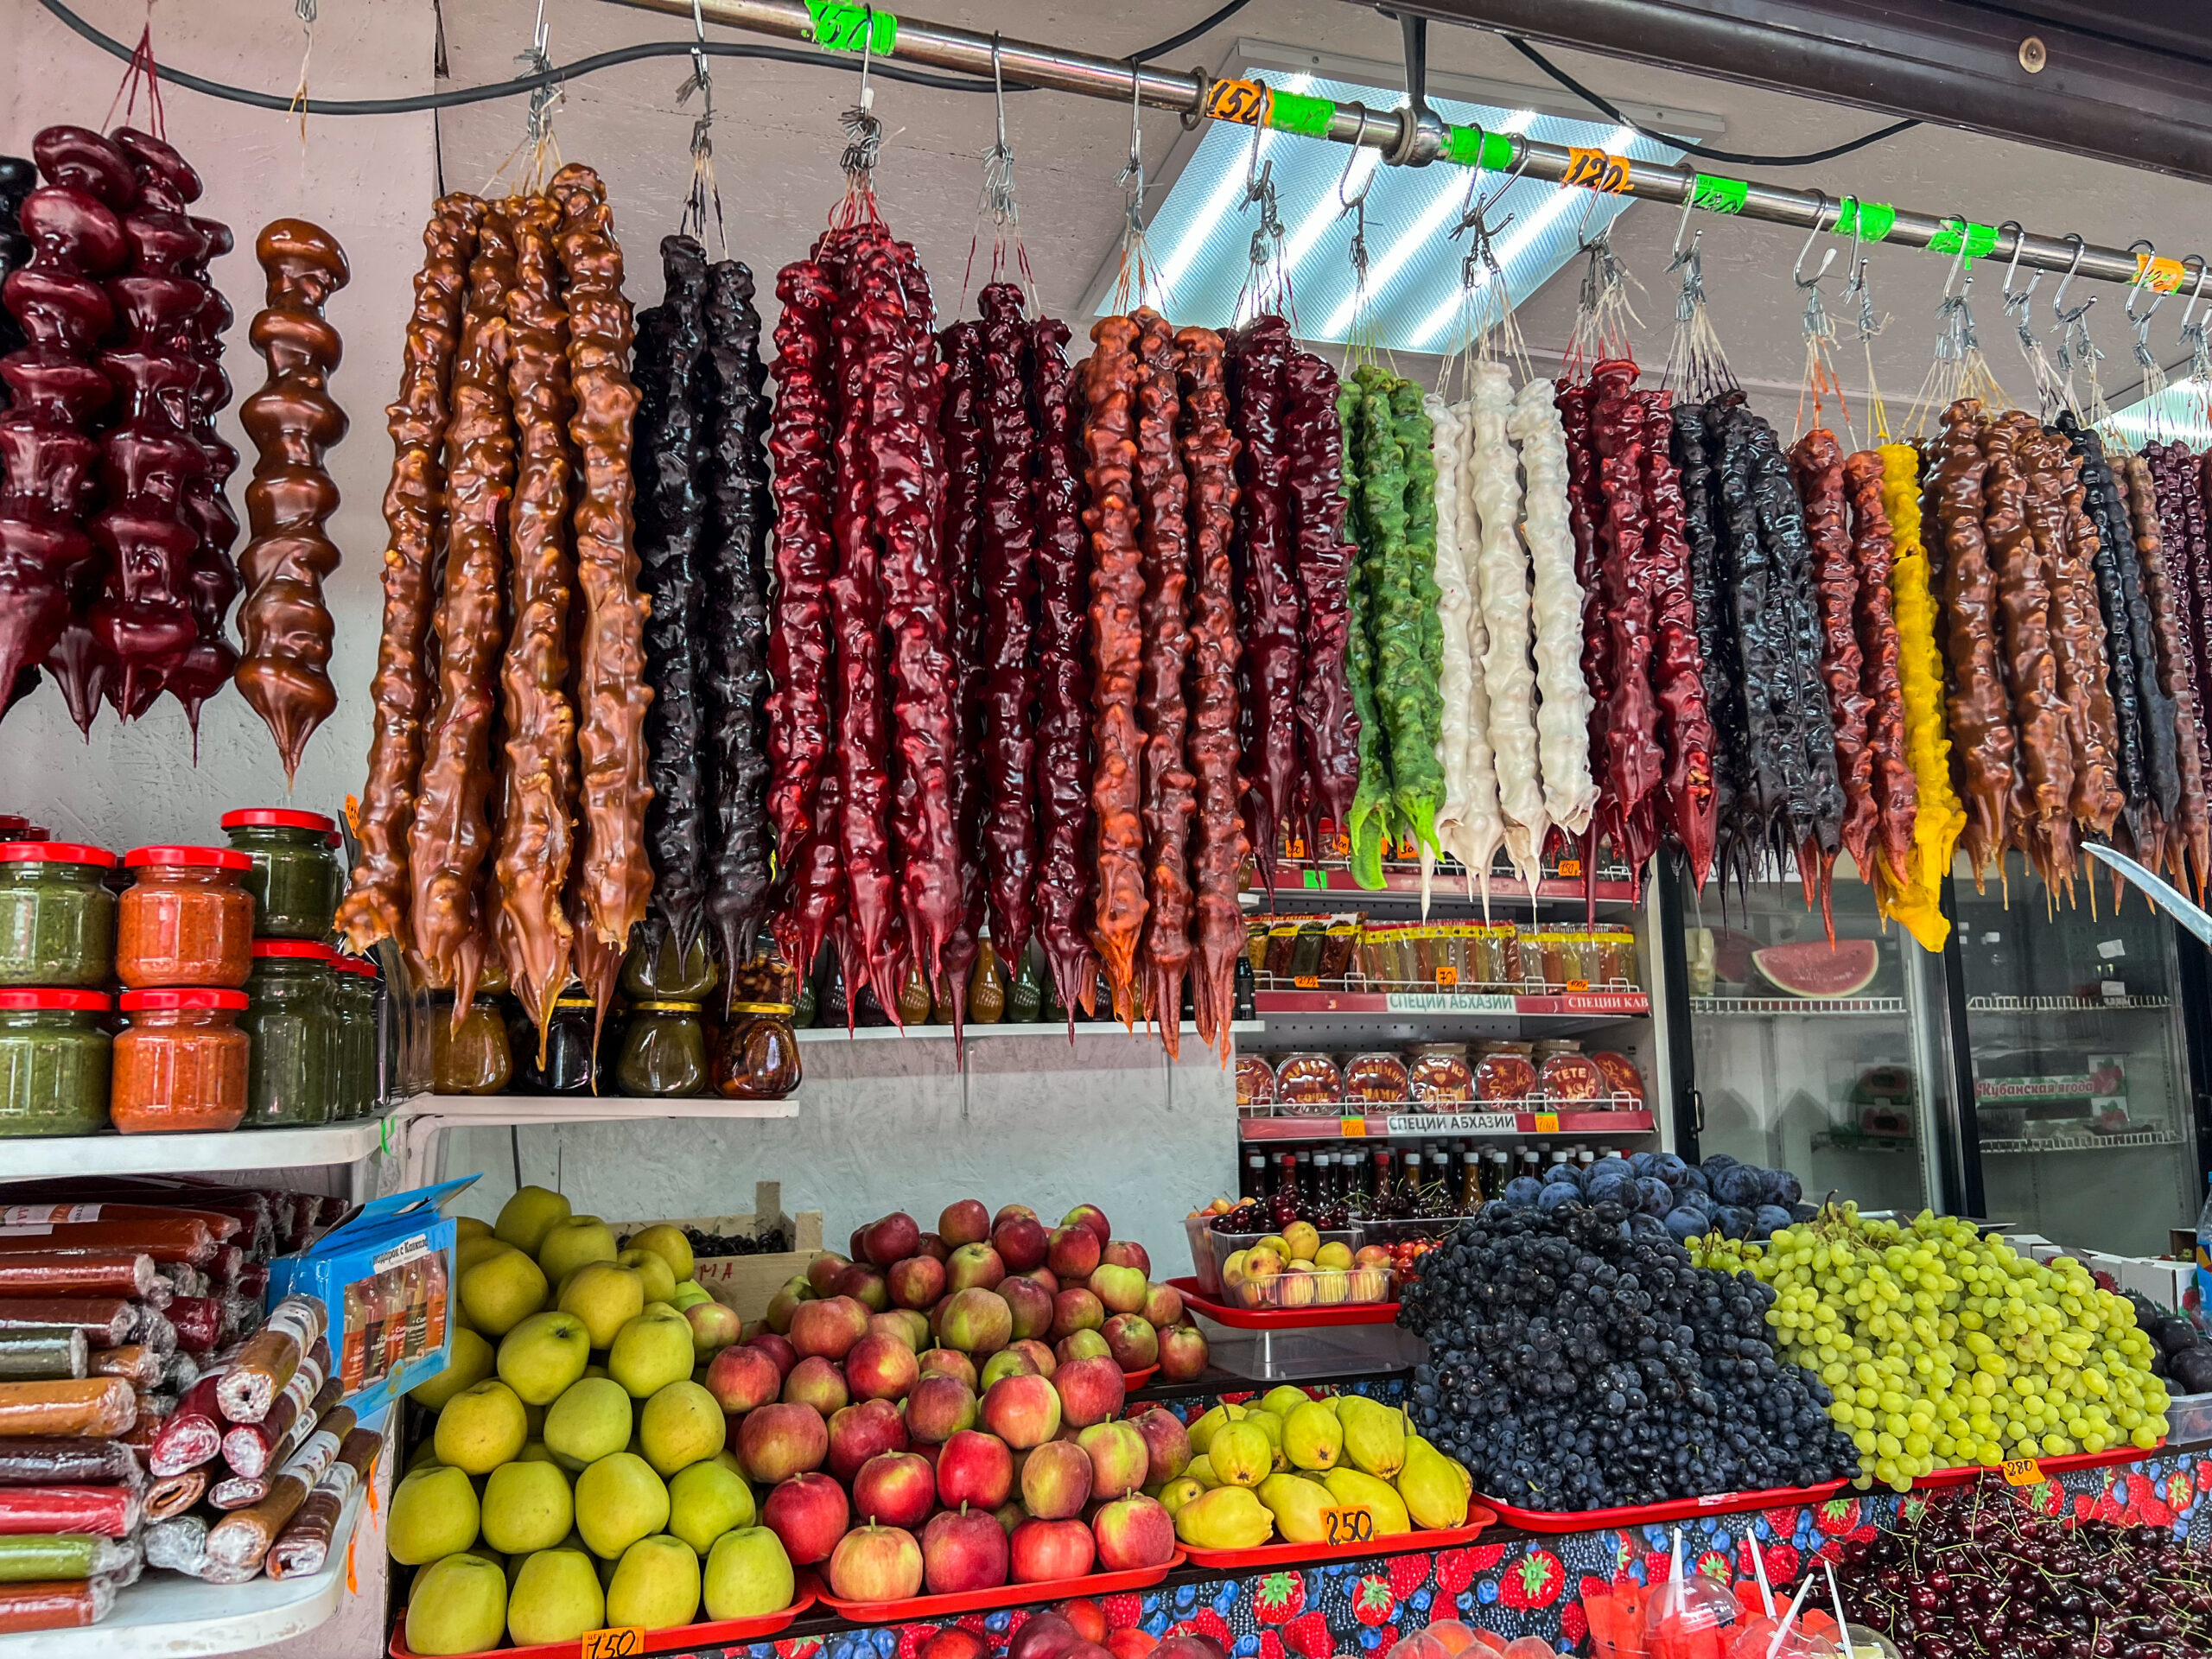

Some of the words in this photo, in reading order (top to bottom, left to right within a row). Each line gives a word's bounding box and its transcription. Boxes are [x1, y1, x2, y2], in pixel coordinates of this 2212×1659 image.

[1207, 82, 1270, 124] 150
[1567, 155, 1624, 194] 120
[1389, 994, 1446, 1011] СПЕЦИИ
[1450, 995, 1513, 1010] АБХАЗИИ
[1567, 996, 1621, 1009] СПЕЦИИ
[1488, 1063, 1531, 1092] Sochi
[1976, 1082, 2056, 1100] Кубанская
[2058, 1081, 2094, 1094] ягода
[1389, 1117, 1446, 1132] СПЕЦИИ
[1451, 1116, 1515, 1128] АБХАЗИИ
[2006, 1459, 2033, 1477] 280
[1326, 1510, 1373, 1546] 250
[587, 1629, 636, 1659] 150
